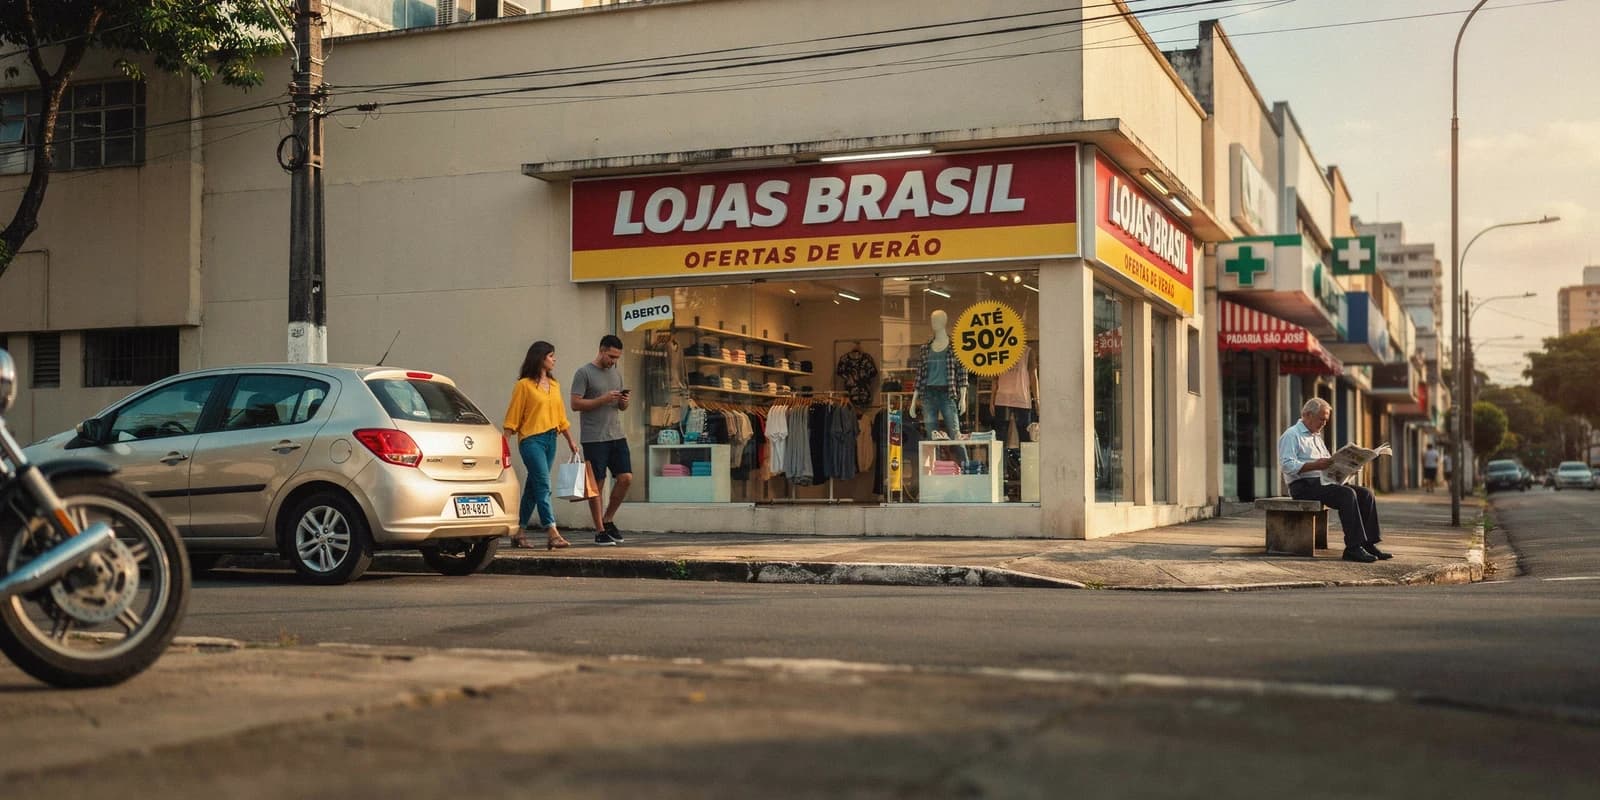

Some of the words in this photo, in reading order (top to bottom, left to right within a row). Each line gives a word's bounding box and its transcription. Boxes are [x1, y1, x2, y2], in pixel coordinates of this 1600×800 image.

[613, 180, 791, 235] LOJAS
[803, 164, 1026, 224] BRASIL
[1109, 176, 1152, 247] LOJAS
[1152, 212, 1188, 275] BRASIL
[685, 247, 797, 268] OFERTAS
[808, 244, 841, 262] DE
[852, 234, 942, 259] VERÃO
[1124, 253, 1149, 283] OFERTAS
[1150, 270, 1157, 288] DE
[624, 304, 670, 320] ABERTO
[970, 308, 1003, 327] ATÉ
[962, 326, 1018, 351] 50%
[1226, 334, 1262, 344] PADARIA
[1263, 331, 1281, 344] SÃO
[1282, 331, 1305, 344] JOSÉ
[973, 350, 1010, 367] OFF
